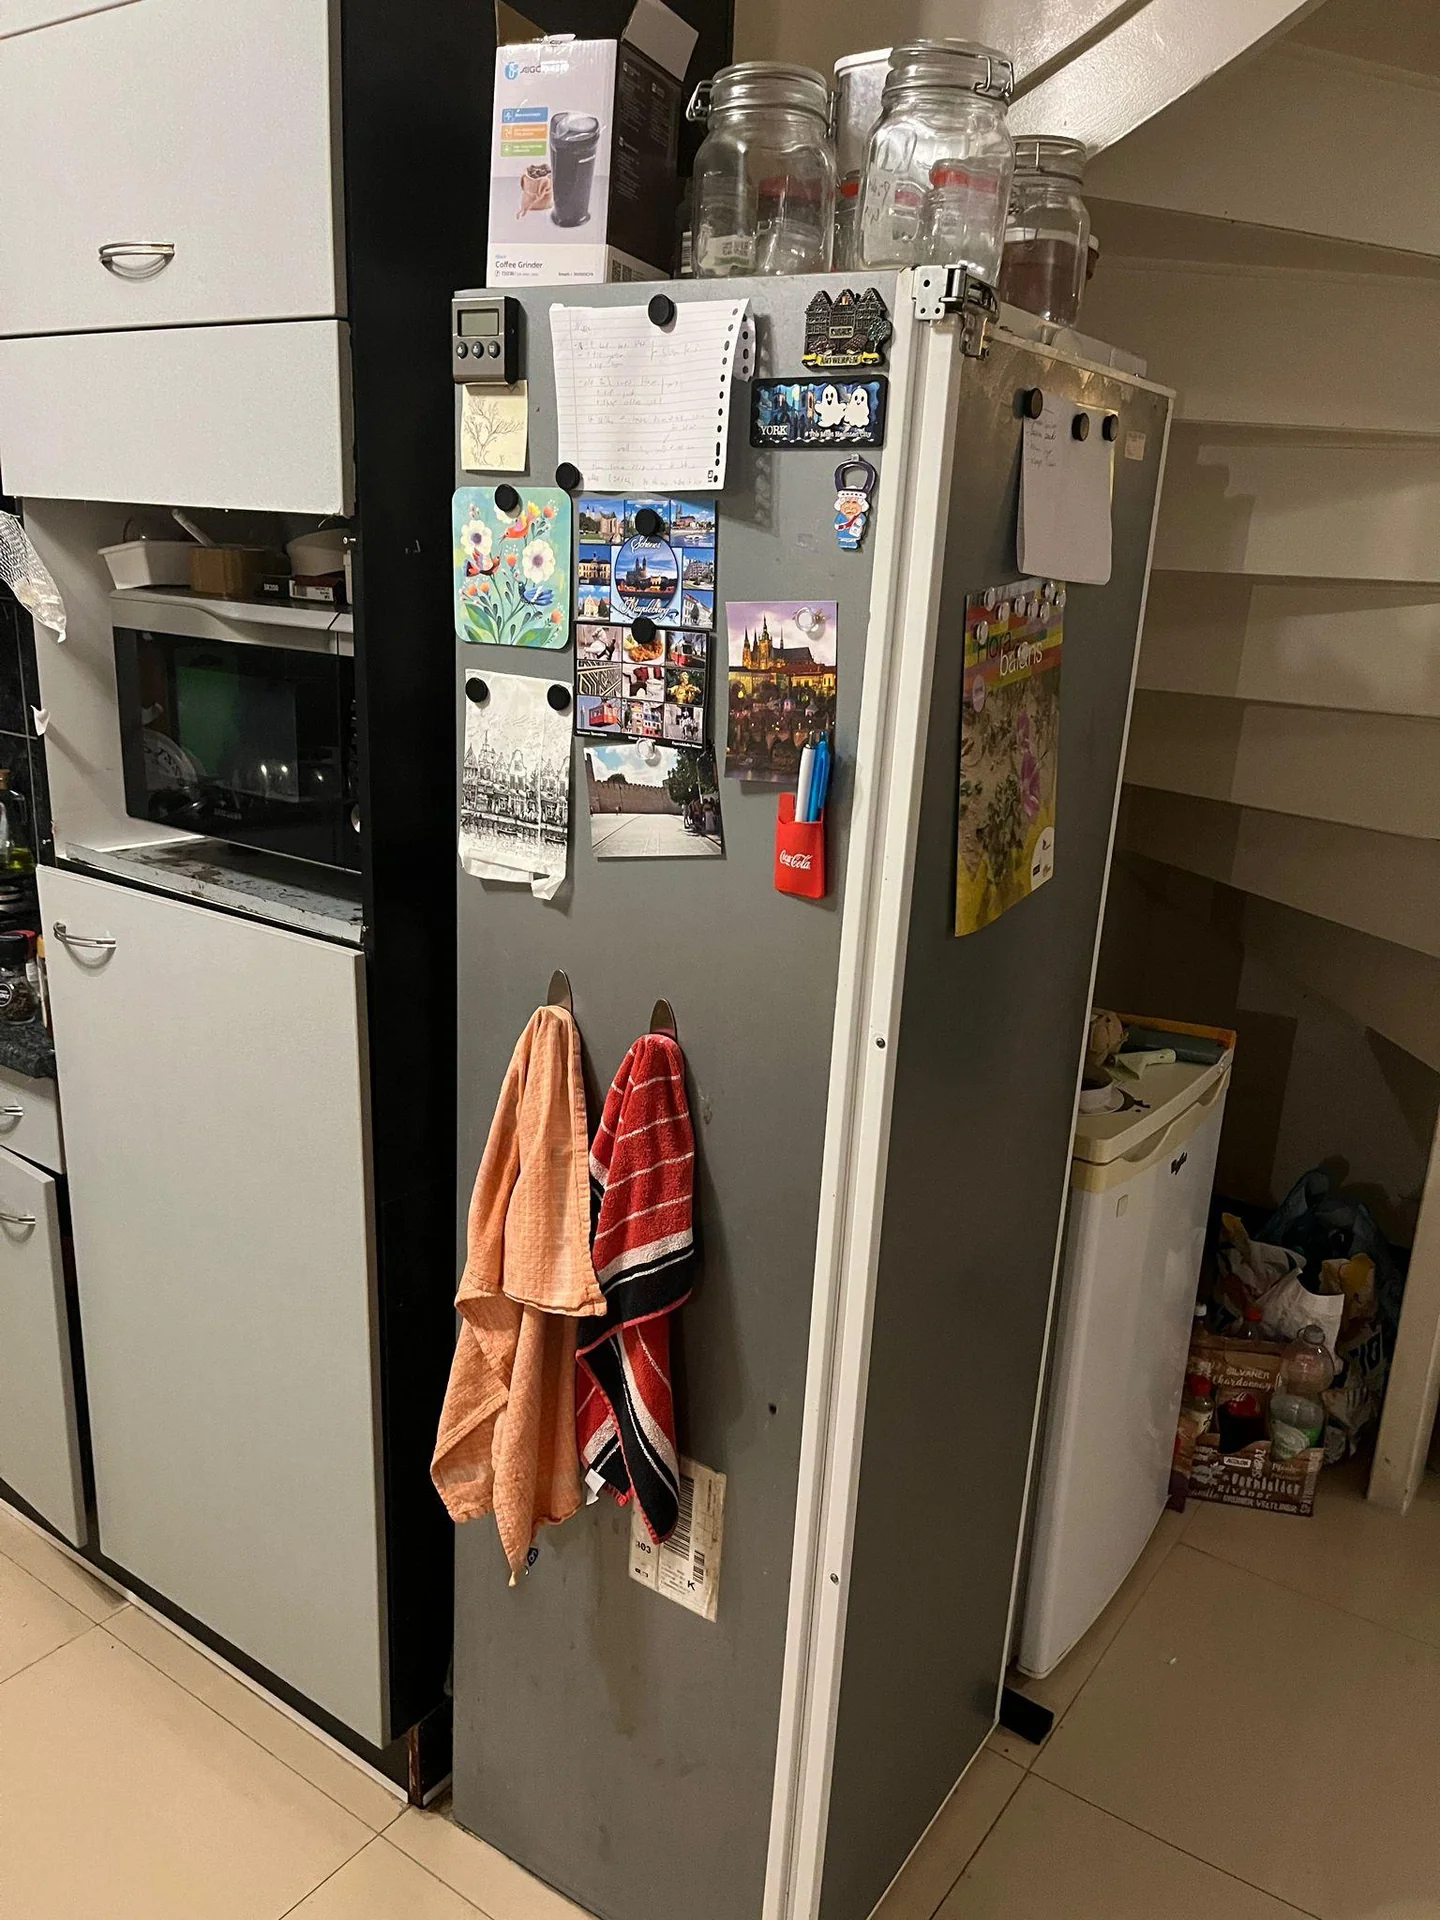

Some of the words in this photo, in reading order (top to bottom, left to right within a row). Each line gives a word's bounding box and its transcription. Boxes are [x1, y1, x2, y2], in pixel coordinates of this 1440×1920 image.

[495, 261, 517, 269] Coffee
[518, 261, 543, 270] Grinder
[760, 425, 788, 436] YORK
[860, 429, 872, 439] City
[1226, 1366, 1270, 1380] SILVANER
[1212, 1374, 1272, 1393] Chardonnay
[1217, 1484, 1273, 1500] Rivaner
[687, 1580, 696, 1591] K
